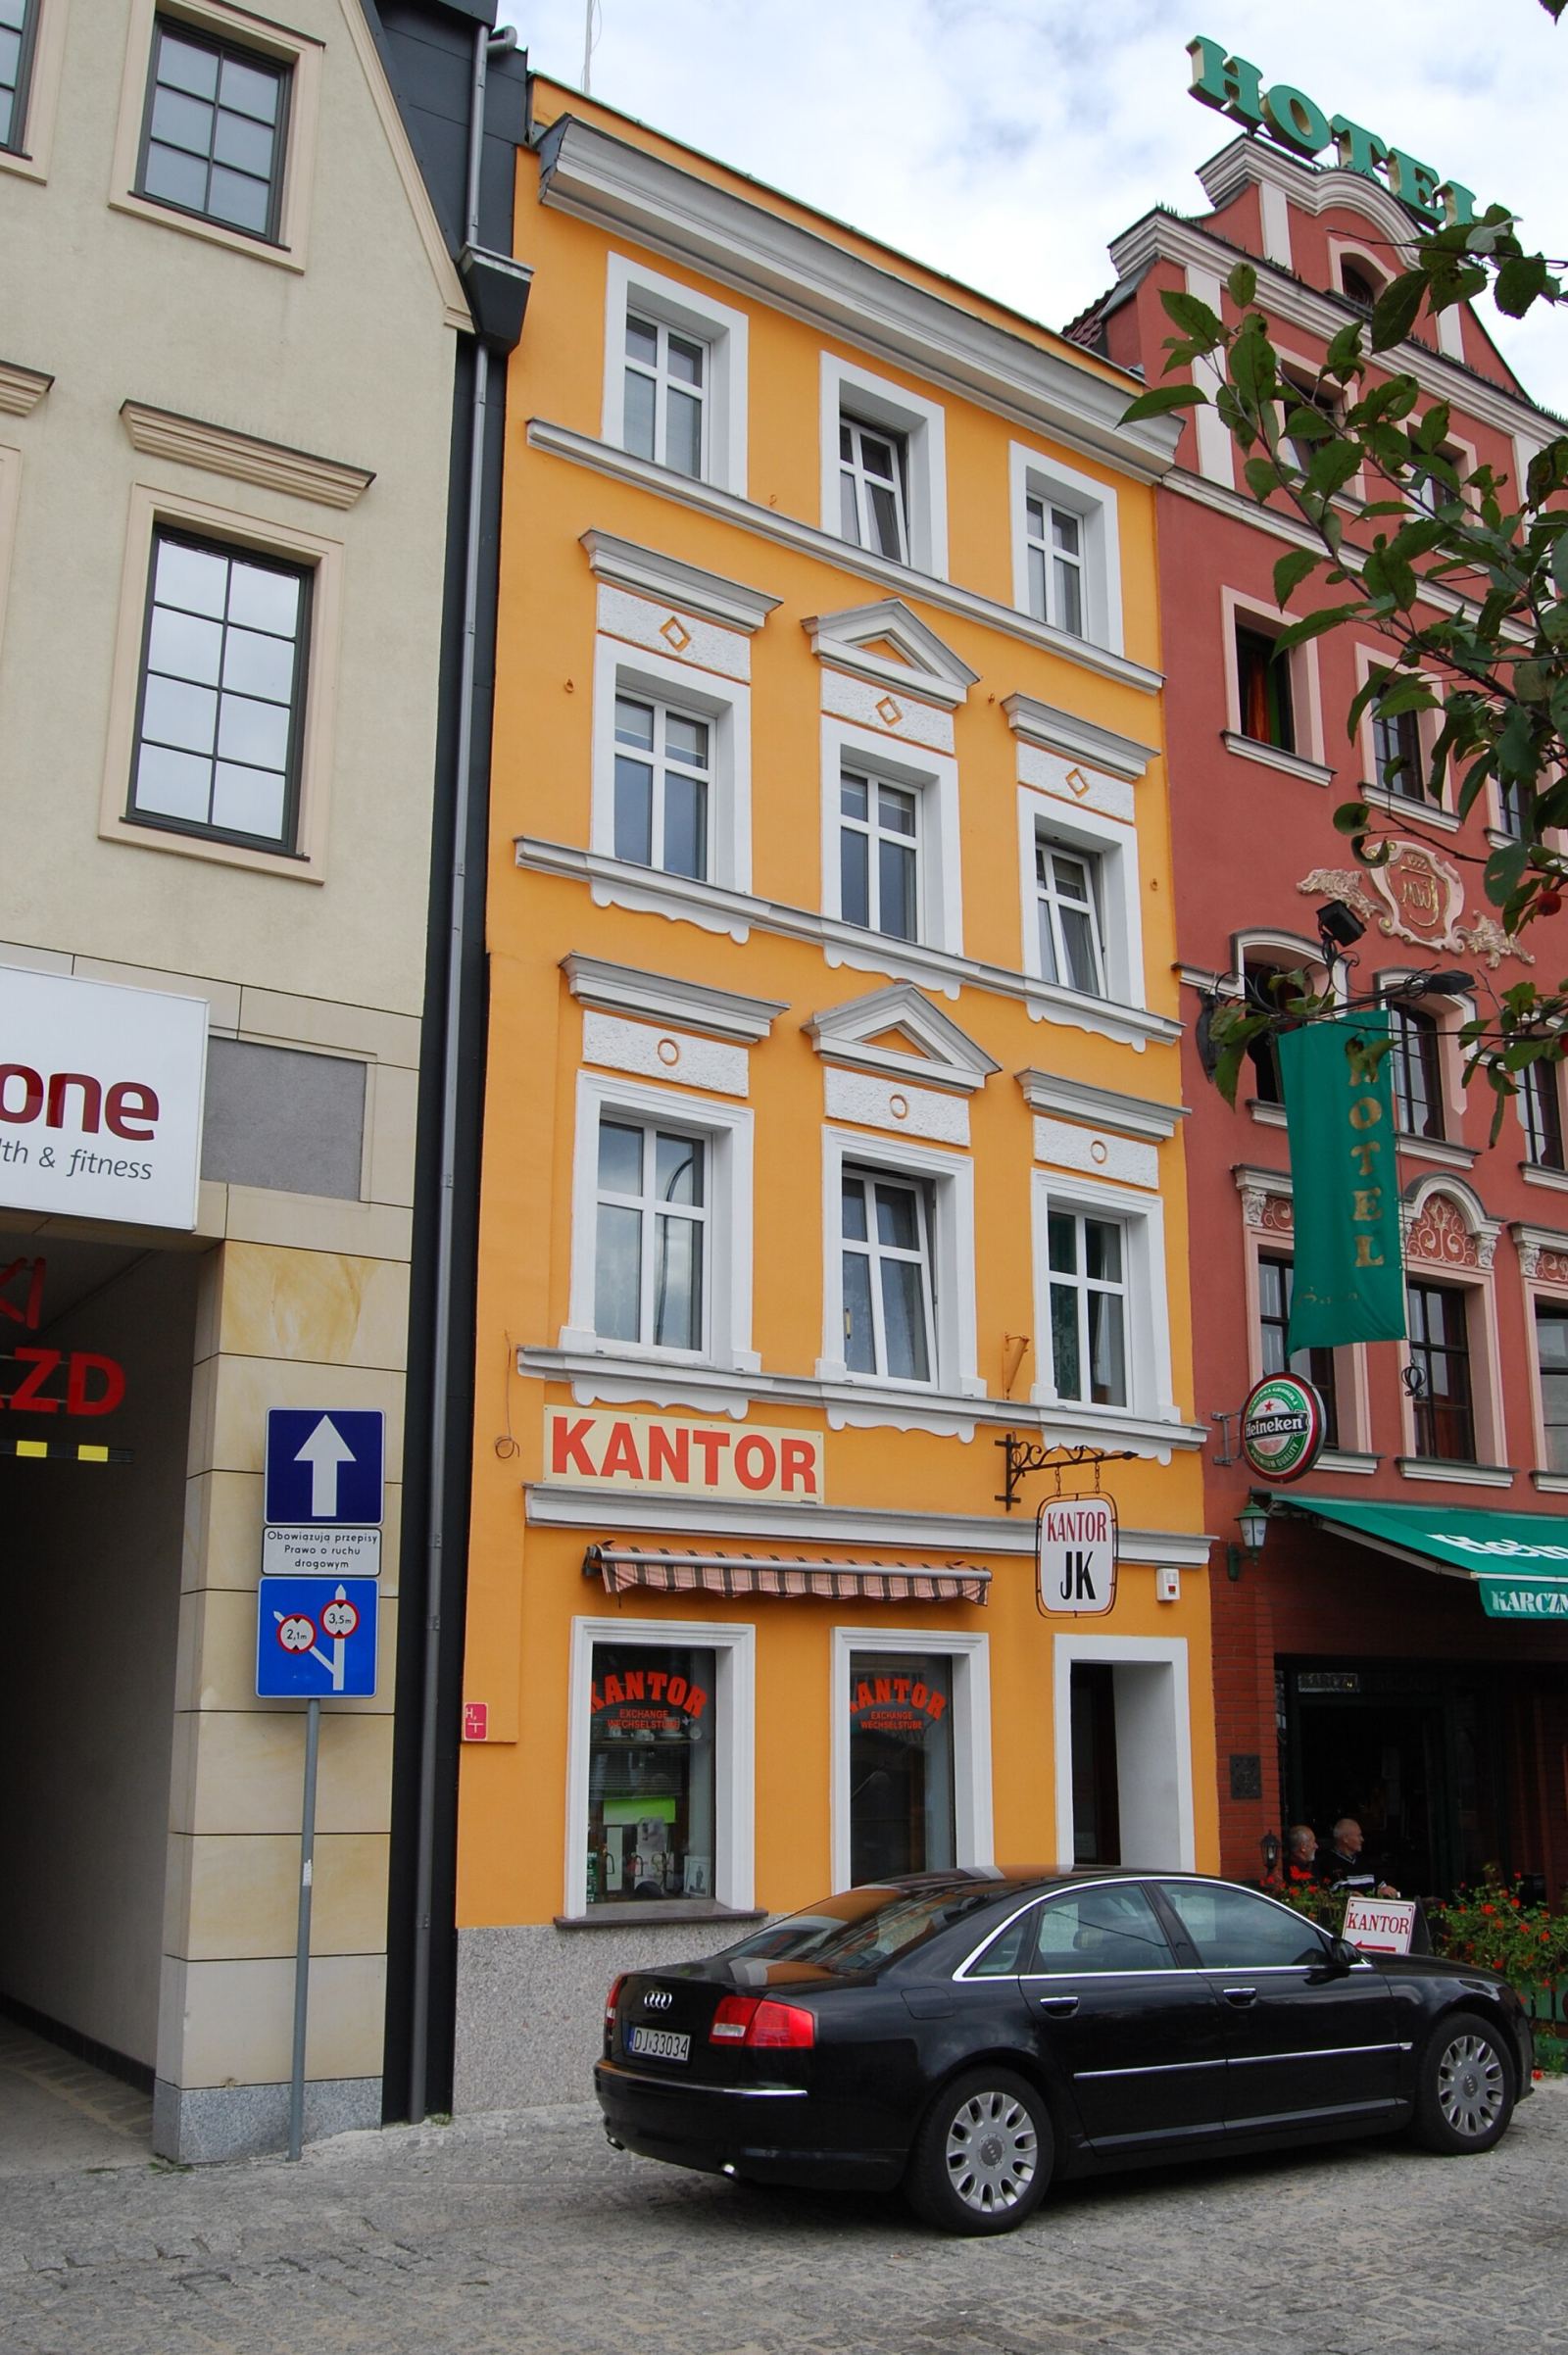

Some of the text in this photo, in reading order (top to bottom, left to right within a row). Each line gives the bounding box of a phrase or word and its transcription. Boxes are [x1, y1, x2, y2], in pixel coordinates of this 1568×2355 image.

[0, 1063, 160, 1142] one
[38, 1147, 56, 1168] &
[67, 1149, 154, 1180] fitness
[0, 1347, 126, 1417] ZD
[1246, 1416, 1303, 1438] Heineken
[552, 1415, 818, 1495] KANTOR
[334, 1533, 378, 1545] przepisy
[1047, 1511, 1107, 1543] KANTOR
[284, 1545, 317, 1554] Prawo
[331, 1546, 361, 1555] ruchu
[294, 1558, 349, 1570] drogowym
[1059, 1550, 1097, 1600] JK
[618, 1708, 669, 1719] EXCHANGE
[870, 1710, 914, 1720] EXCHANGE
[1346, 1912, 1410, 1935] KANTOR
[652, 2033, 689, 2059] 33034
